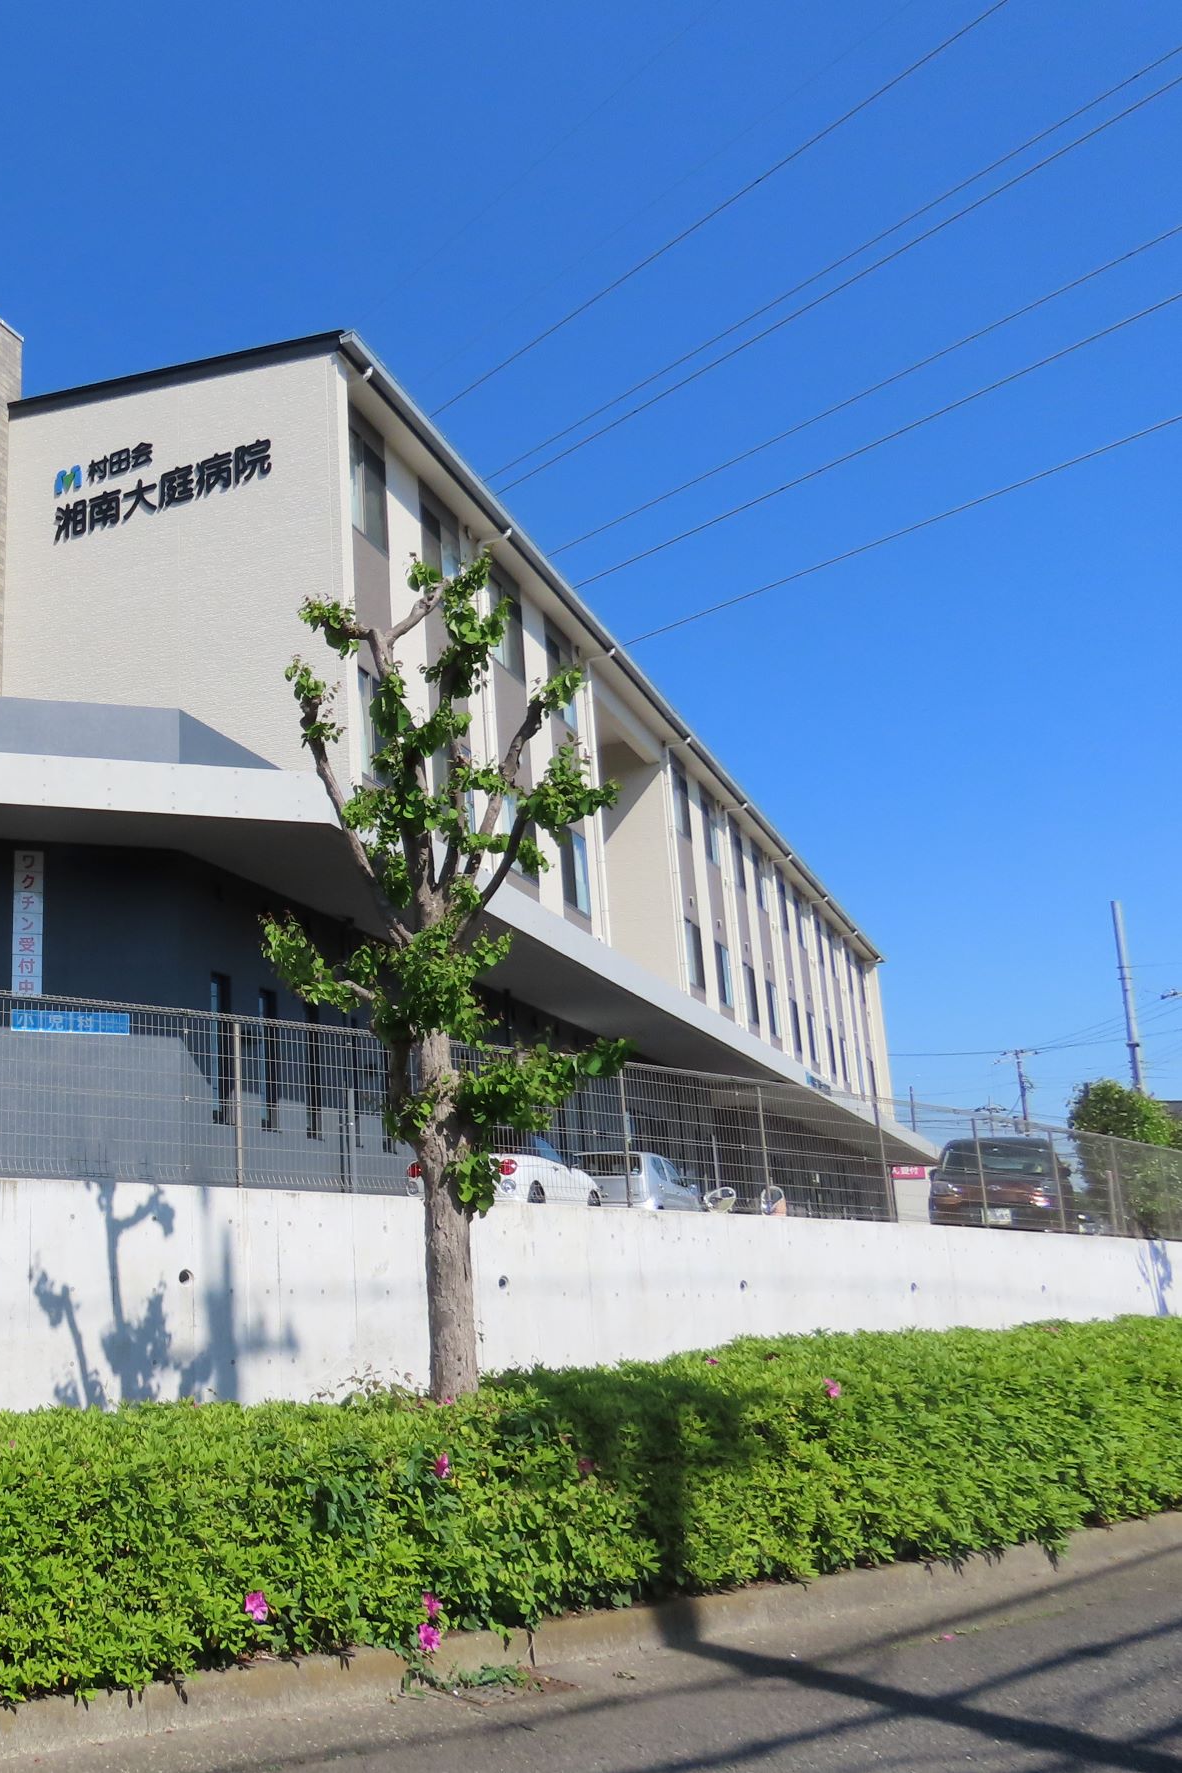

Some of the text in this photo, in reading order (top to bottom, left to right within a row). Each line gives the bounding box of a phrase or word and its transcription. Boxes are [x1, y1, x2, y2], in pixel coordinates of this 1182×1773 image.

[54, 439, 271, 544] 湘南大庭病院
[87, 442, 153, 482] 村田会
[18, 854, 36, 996] ワクチン受付中
[17, 1012, 94, 1032] 小児科
